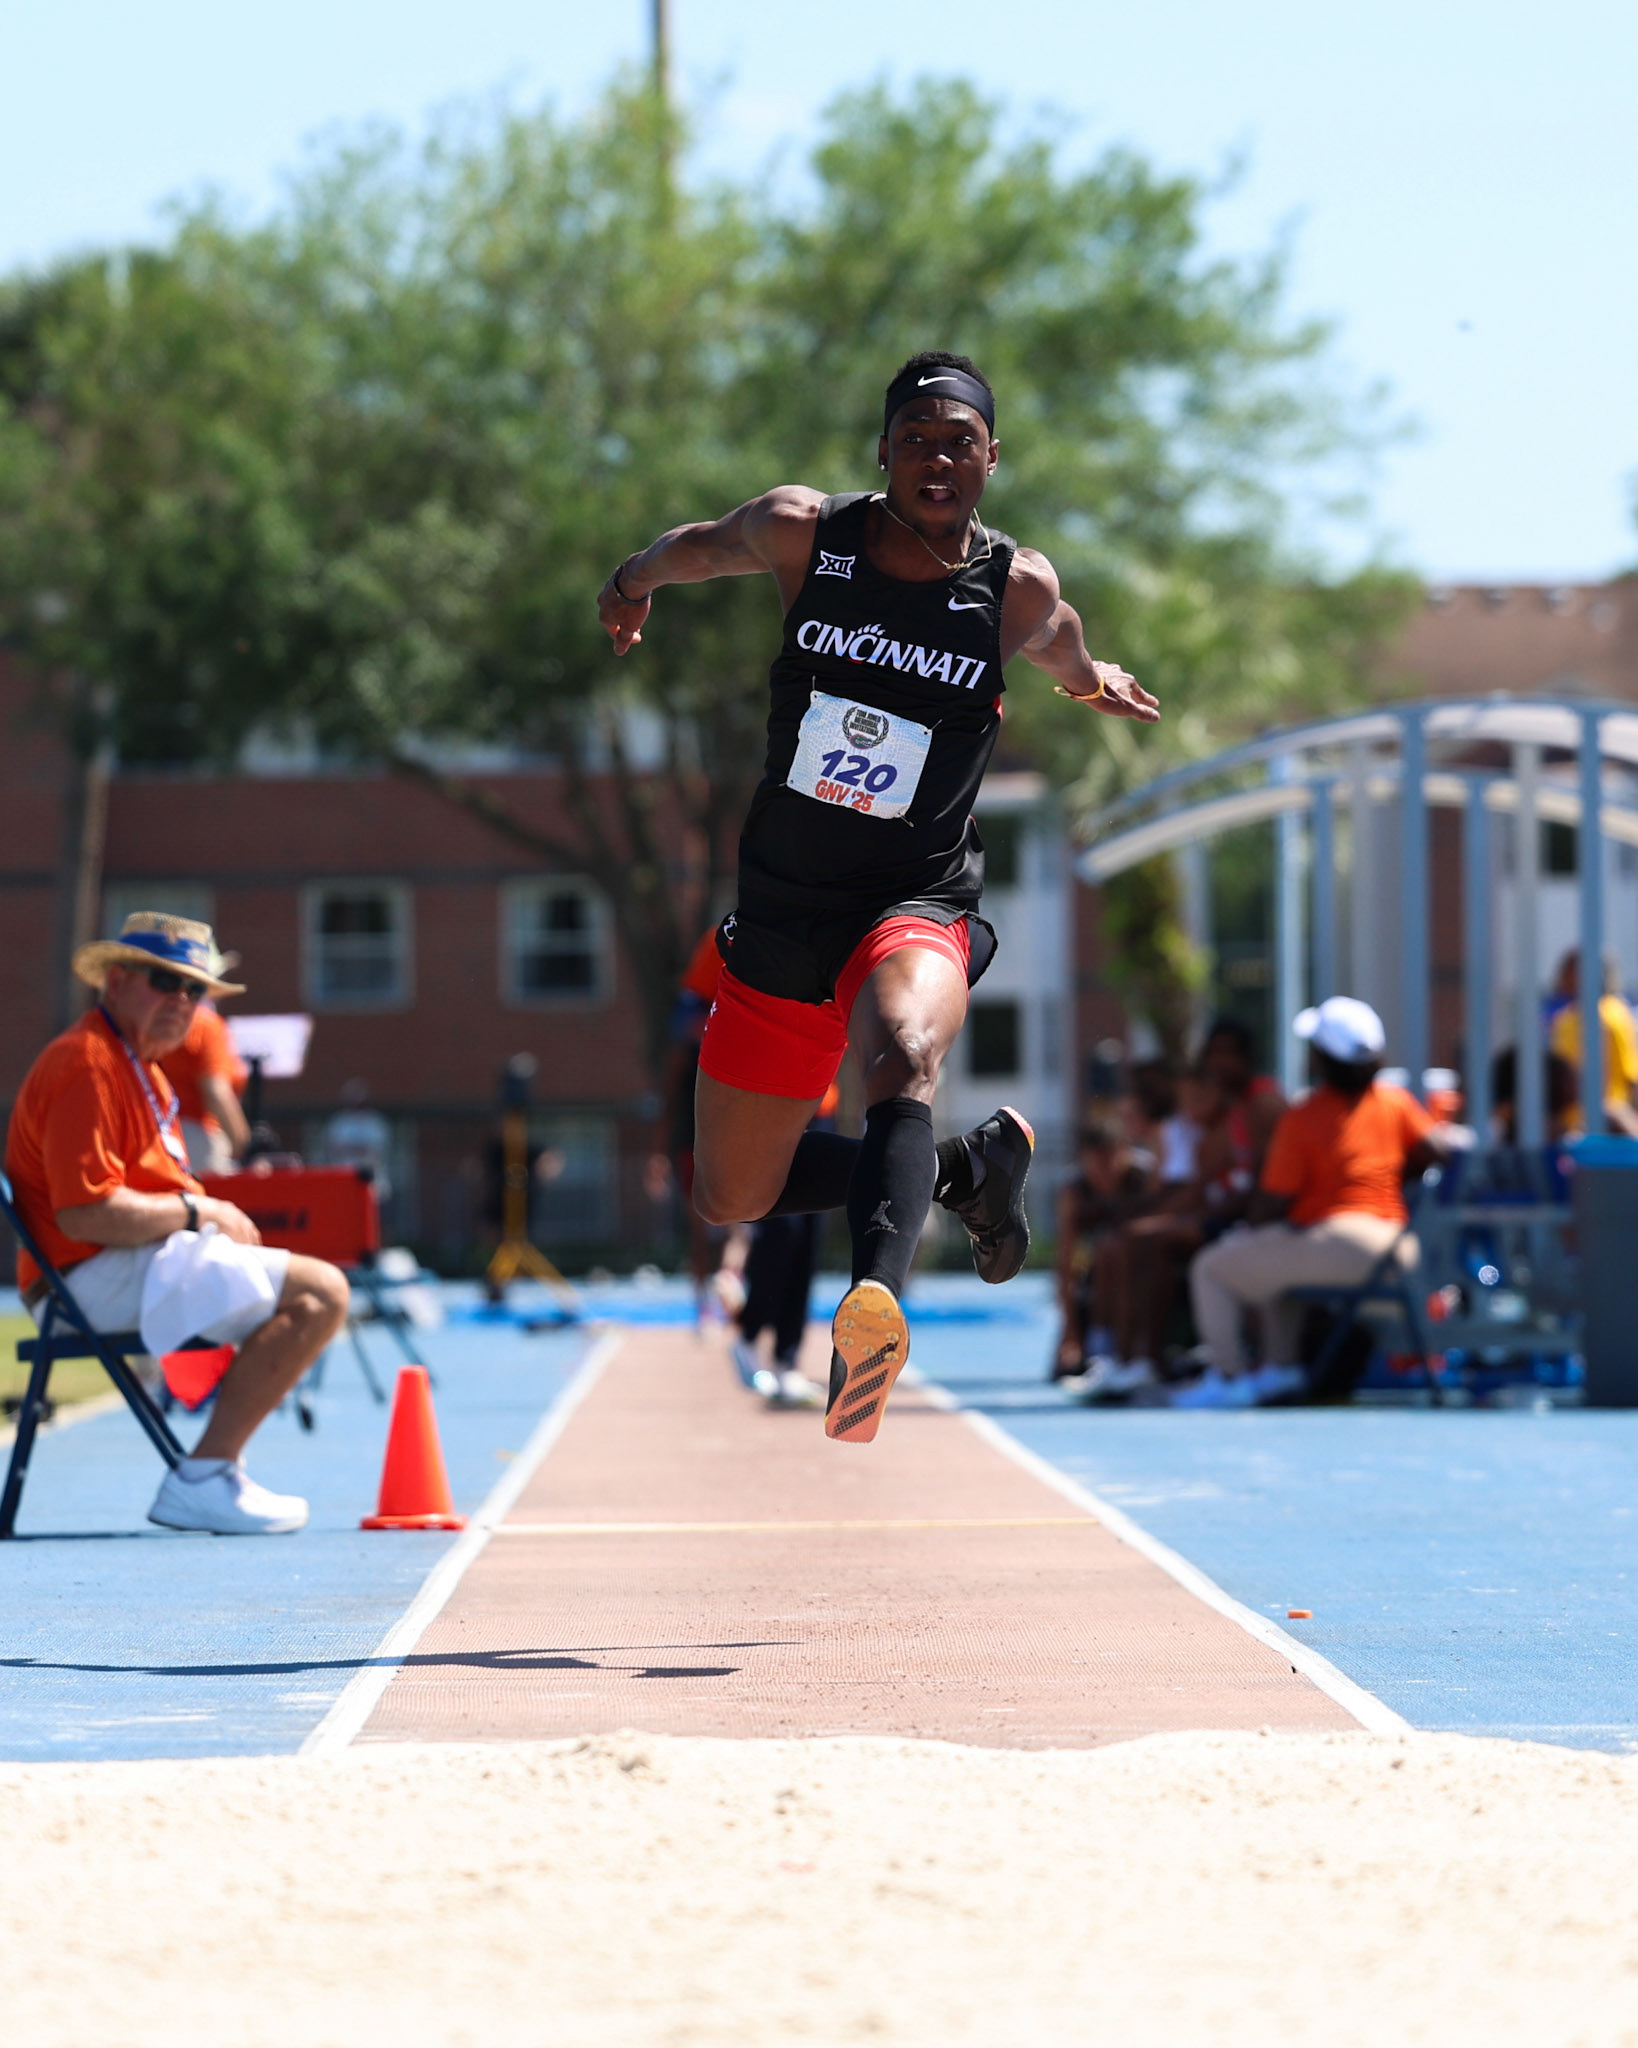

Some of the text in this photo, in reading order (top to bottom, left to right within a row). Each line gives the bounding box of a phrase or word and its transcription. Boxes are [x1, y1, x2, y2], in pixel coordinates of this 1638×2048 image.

[797, 620, 987, 689] CINCINNATI
[821, 749, 898, 793] 120
[815, 779, 875, 812] GNV '25
